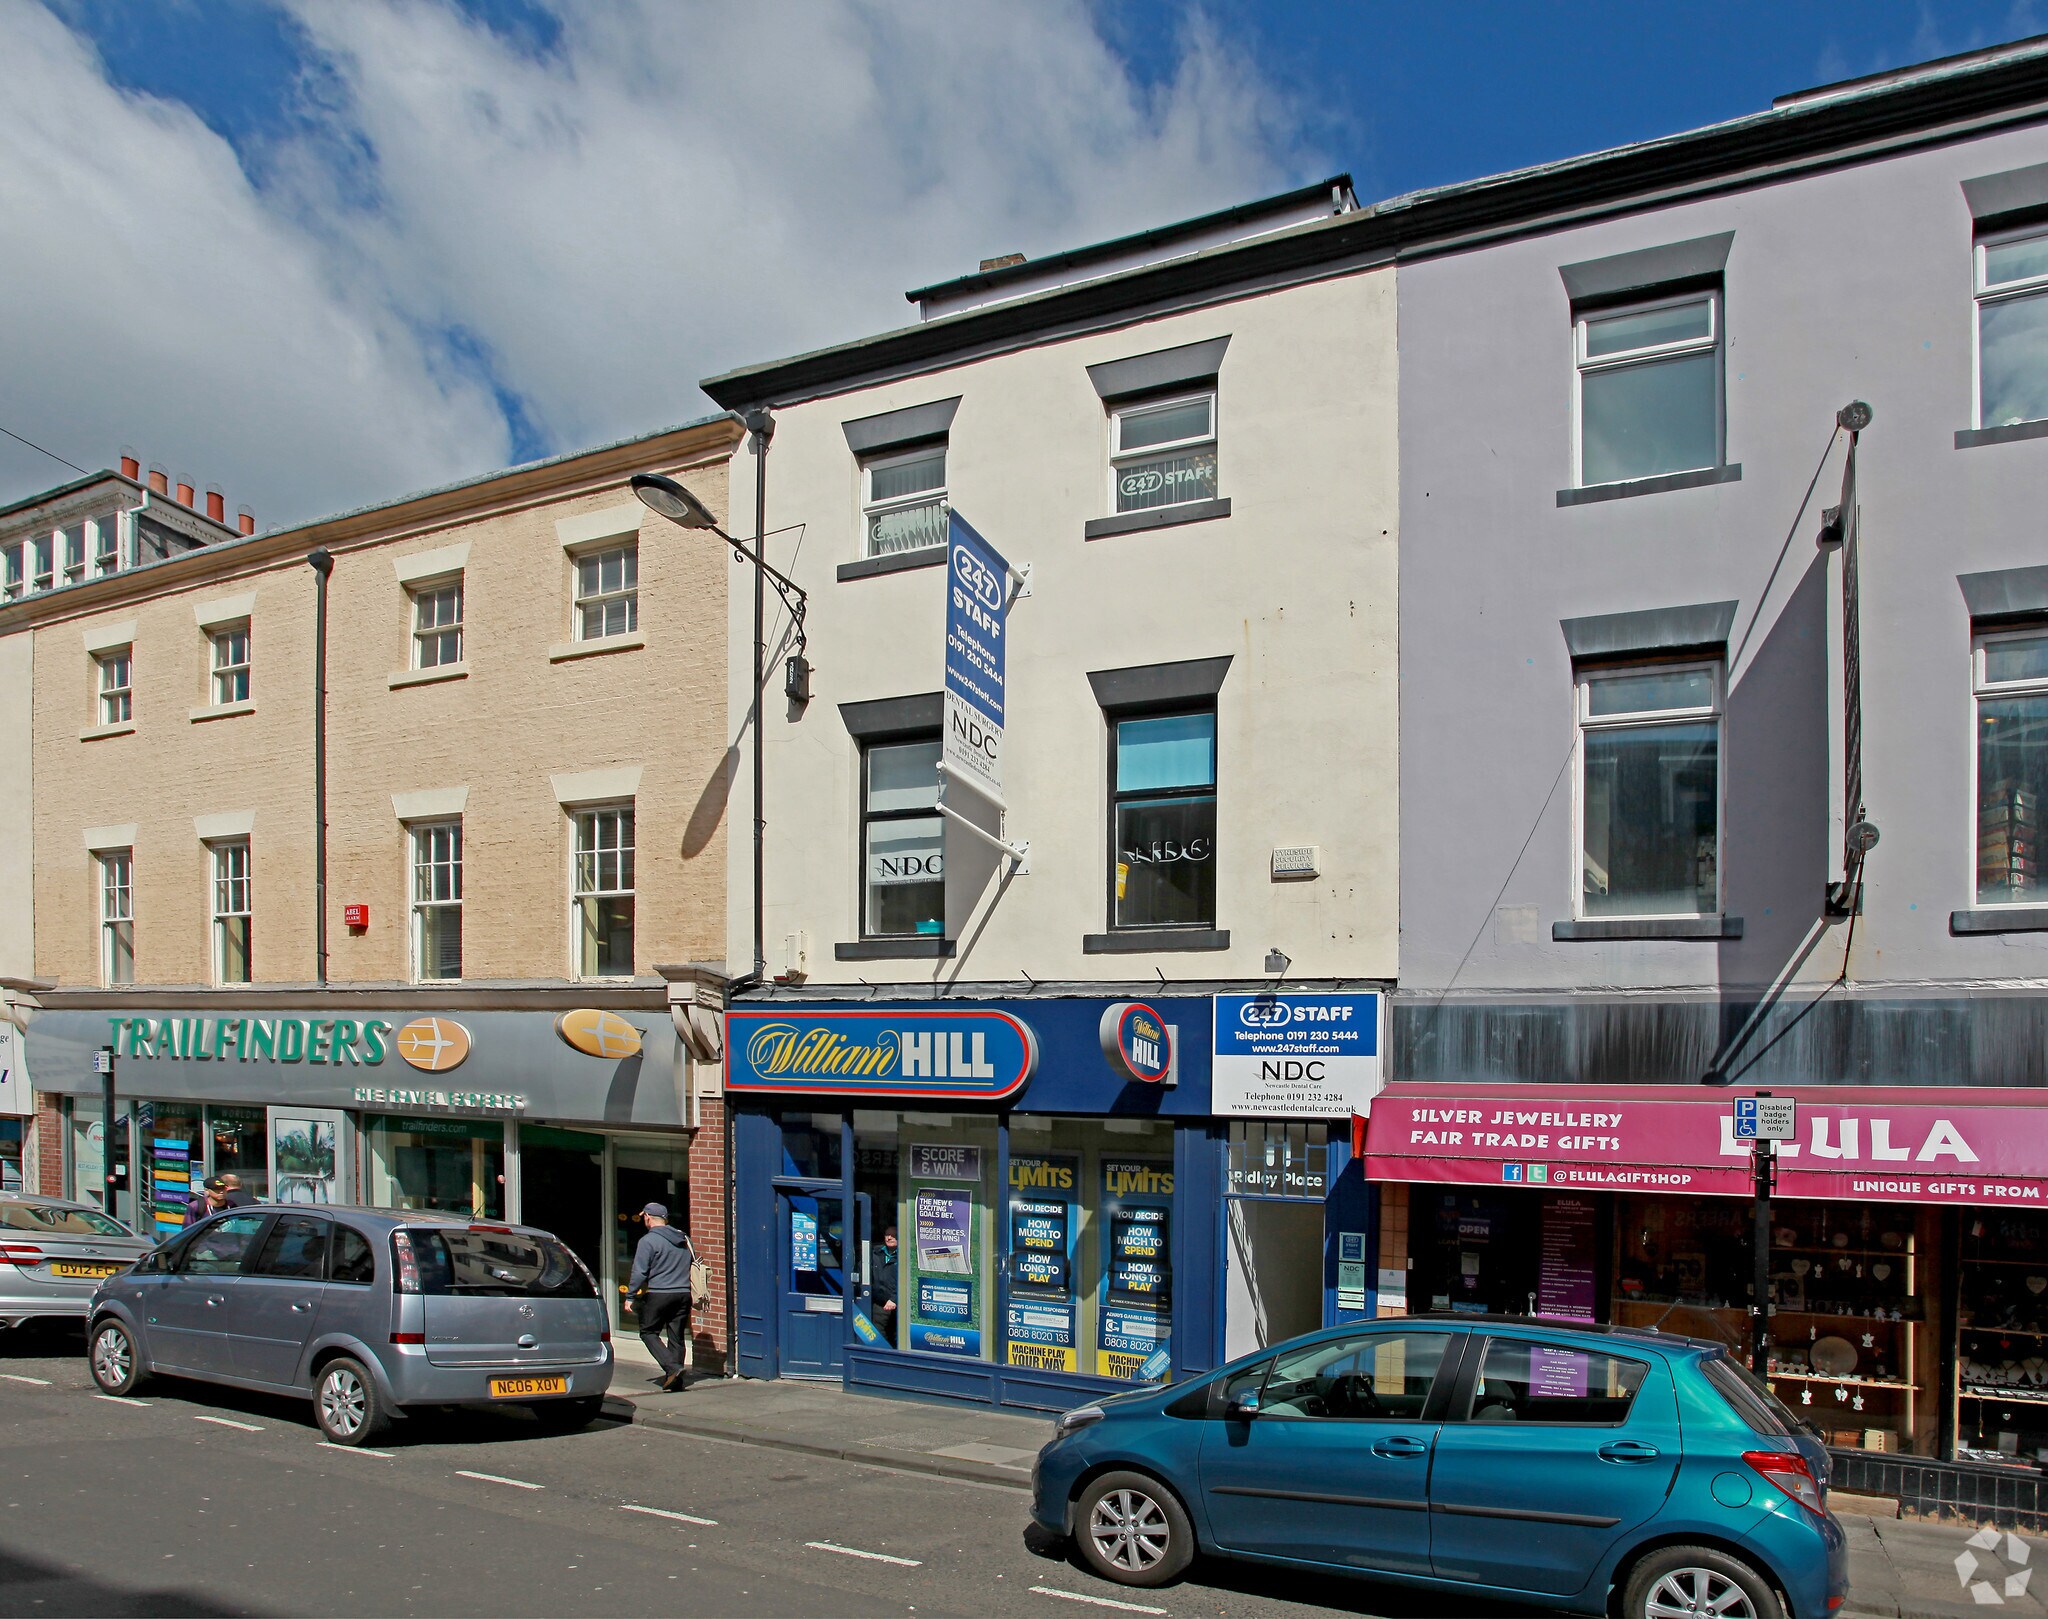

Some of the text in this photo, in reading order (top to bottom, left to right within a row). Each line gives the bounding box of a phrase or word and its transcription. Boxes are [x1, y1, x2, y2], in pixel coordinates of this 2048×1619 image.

[1126, 465, 1213, 492] 247 STAFF
[961, 556, 993, 598] 247
[953, 586, 1000, 639] STAFF
[956, 624, 996, 665] Telephone
[948, 634, 1003, 686] 0191 230 5444
[947, 664, 1003, 714] www.247staff.com
[946, 690, 1004, 739] DENTAL SURGERY
[952, 709, 997, 760] NDC
[880, 855, 944, 877] NDC
[1247, 1006, 1354, 1022] 247 STAFF
[1132, 1015, 1160, 1041] William
[107, 1018, 391, 1066] TRAILFINDERS
[1234, 1031, 1359, 1042] Telephone 0191 230 5444
[746, 1022, 994, 1078] William HILL
[1132, 1036, 1160, 1070] HILL
[1251, 1043, 1340, 1053] www.247staff.com
[1261, 1060, 1326, 1081] NDC
[352, 1088, 526, 1111] THE TRAVEL EXPERTS
[1244, 1091, 1343, 1102] Telephone 0191 232 4284
[1231, 1103, 1357, 1113] www.newcastledentalcare.co.uk
[1741, 1101, 1754, 1116] P
[1411, 1109, 1623, 1128] SILVER JEWELLERY
[402, 1120, 467, 1133] trailfinders.com
[1410, 1130, 1620, 1151] FAIR TRADE GIFTS
[921, 1147, 965, 1163] SCORE
[921, 1161, 962, 1177] & WIN.
[1008, 1159, 1041, 1167] SET YOUR
[1106, 1164, 1141, 1172] SET YOUR
[1008, 1162, 1073, 1191] LIMITS
[1106, 1168, 1174, 1198] LIMITS
[1234, 1170, 1323, 1189] Ridley Place
[1553, 1170, 1692, 1185] @ELULAGIFTSHOP
[1852, 1180, 2040, 1198] UNIQUE GIFTS FROM
[919, 1204, 947, 1212] EXCITING
[919, 1210, 940, 1218] GOALS
[1018, 1204, 1063, 1214] YOU DECIDE
[1117, 1210, 1164, 1221] YOU DECIDE
[919, 1226, 942, 1234] BIGGER
[1027, 1219, 1052, 1229] HOW
[1458, 1224, 1490, 1235] OPEN
[919, 1233, 942, 1241] BIGGER
[1018, 1228, 1061, 1239] MUCH TO
[1127, 1227, 1153, 1237] HOW
[1025, 1237, 1054, 1248] SPEND
[1117, 1236, 1163, 1247] MUCH TO
[1124, 1245, 1156, 1256] SPEND
[1027, 1253, 1051, 1264] HOW
[60, 1264, 92, 1276] OV12
[1020, 1263, 1060, 1275] LONG TO
[1127, 1262, 1153, 1273] HOW
[1028, 1273, 1051, 1283] PLAY
[1119, 1271, 1162, 1283] LONG TO
[1128, 1281, 1152, 1292] PLAY
[921, 1303, 968, 1315] 0808 8020 133
[950, 1335, 966, 1345] HILL
[1008, 1327, 1030, 1339] 0808
[1031, 1331, 1053, 1342] 8020
[1056, 1333, 1069, 1343] 133
[1011, 1344, 1066, 1359] MACHINE PLAY
[1104, 1337, 1128, 1349] 0808
[1129, 1340, 1154, 1352] 8020
[1011, 1354, 1066, 1371] YOUR WAY
[498, 1378, 560, 1394] NC06 XOV
